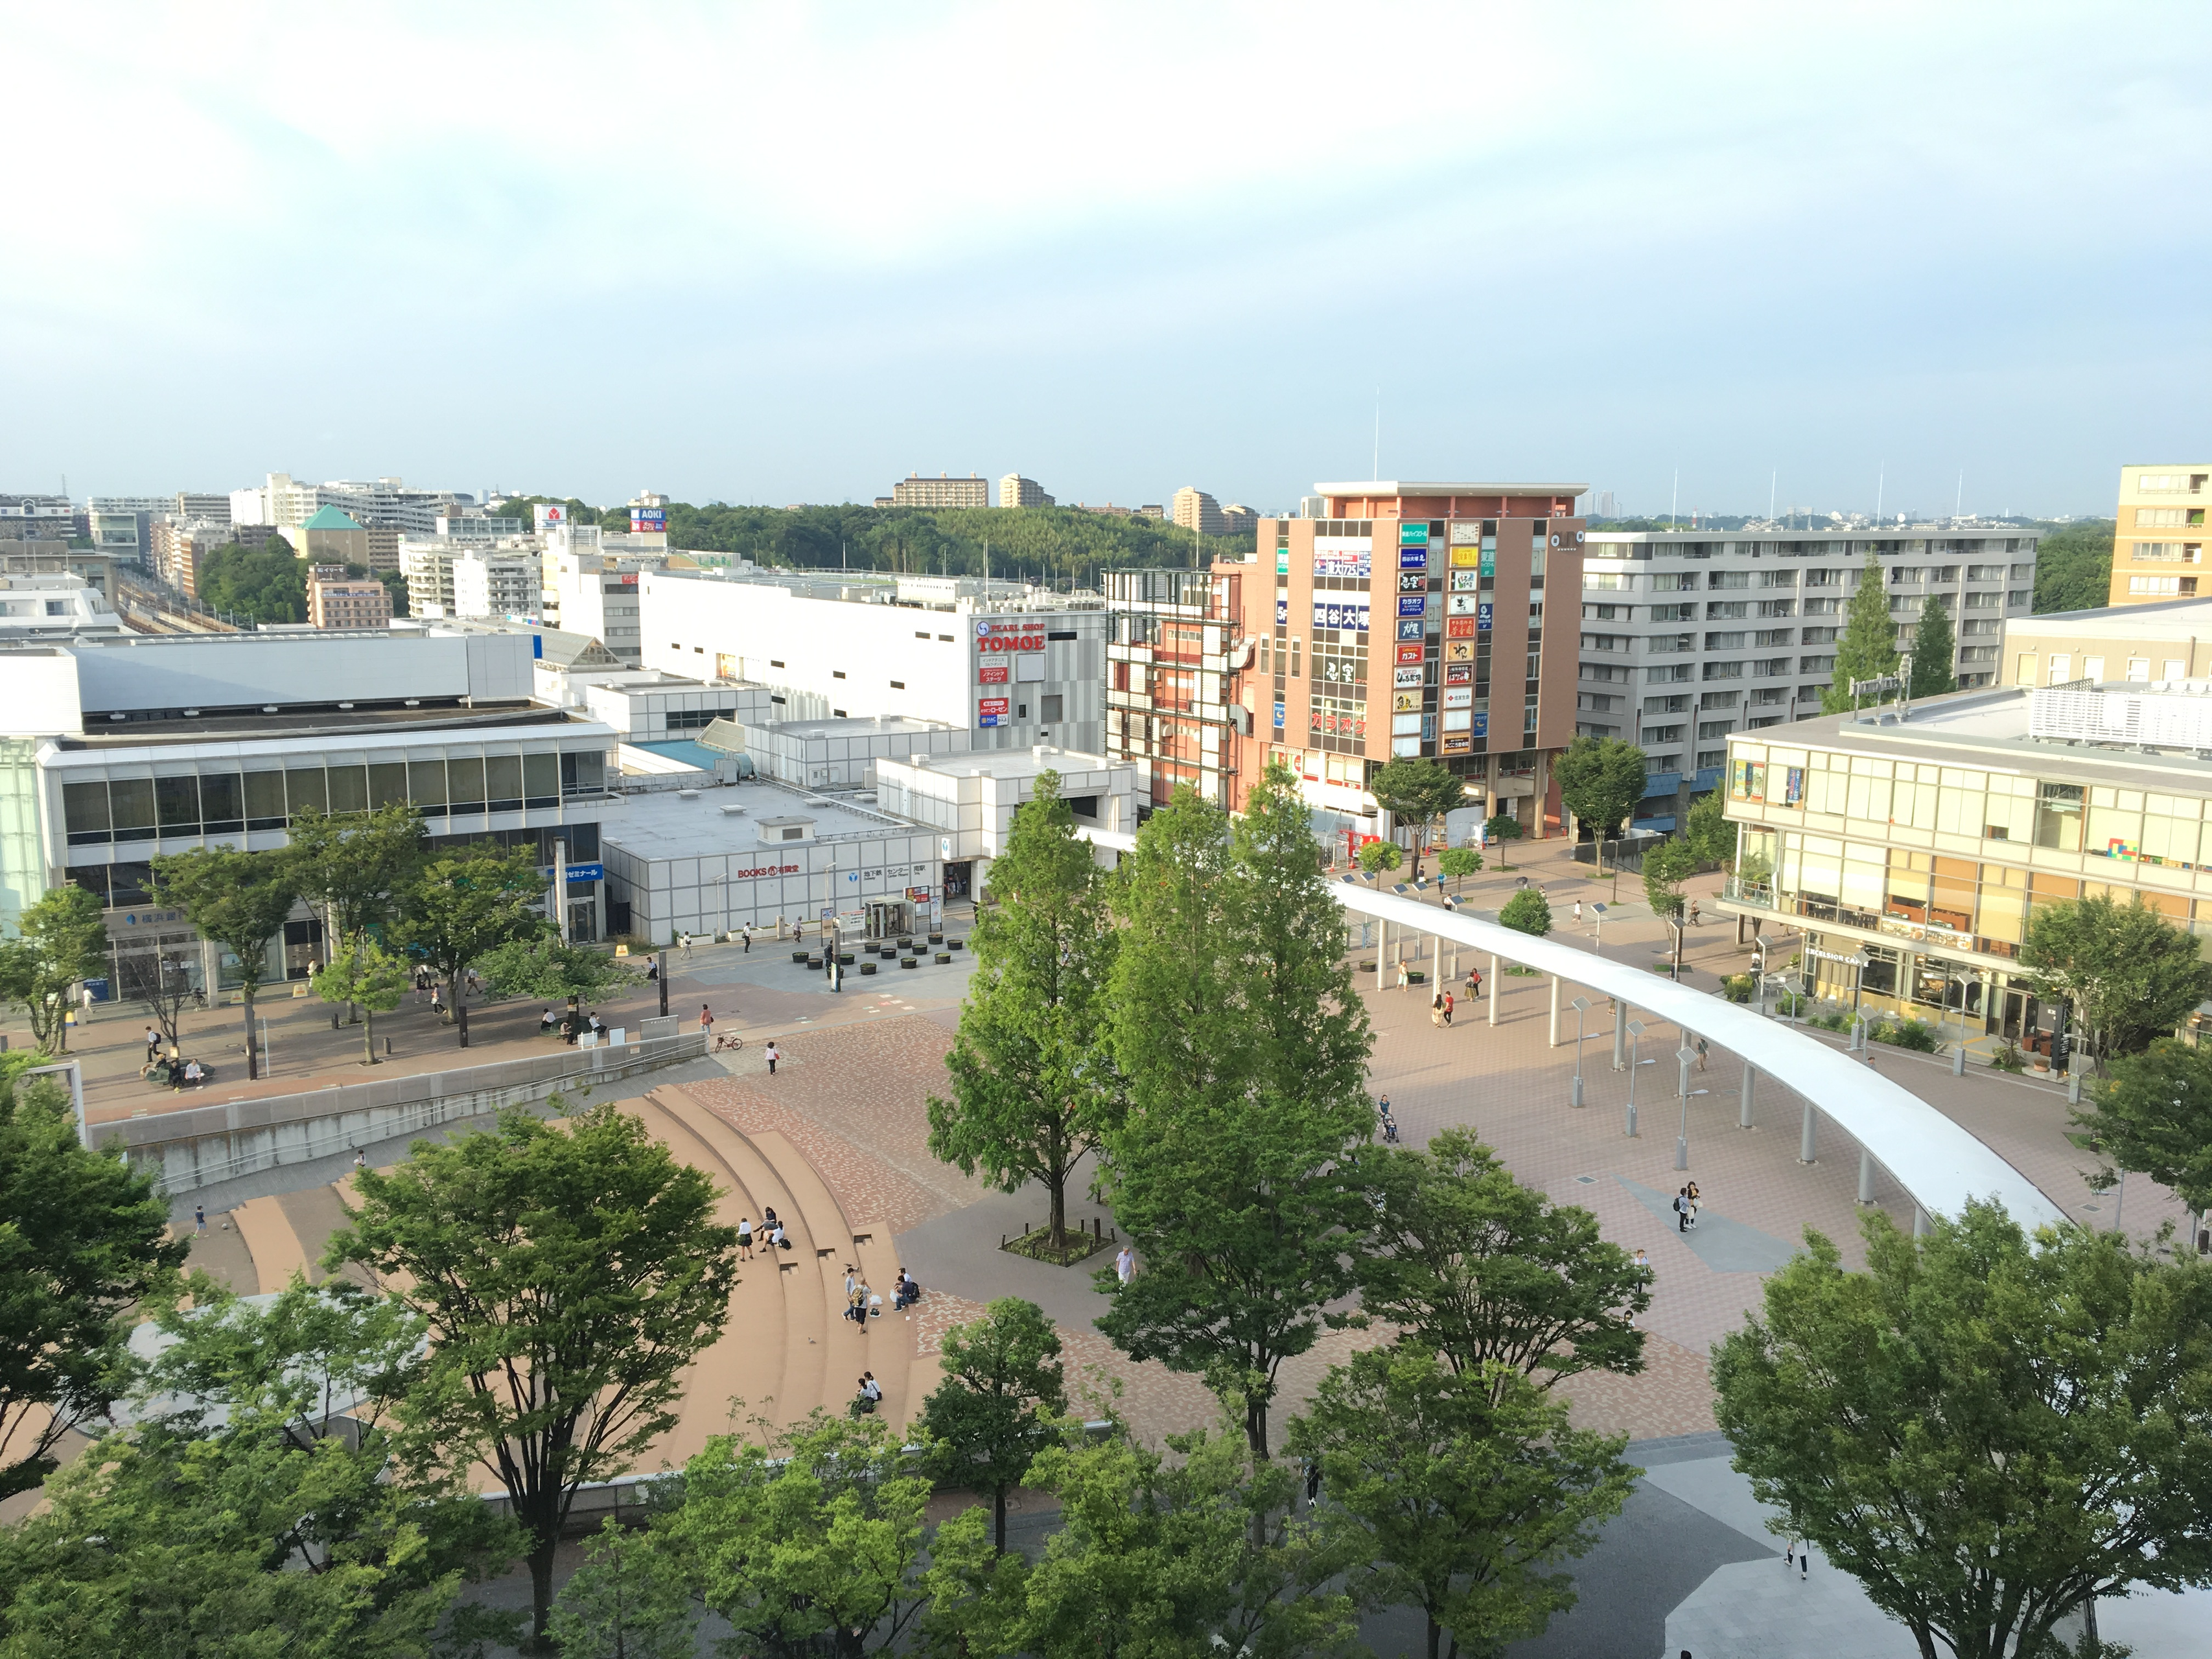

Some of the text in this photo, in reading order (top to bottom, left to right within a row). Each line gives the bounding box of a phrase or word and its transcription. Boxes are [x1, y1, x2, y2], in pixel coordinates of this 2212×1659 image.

[642, 510, 662, 518] AOKI
[1314, 609, 1370, 627] 四谷大塚
[977, 635, 1045, 652] TOMOE
[1310, 712, 1367, 734] カラオケ
[565, 869, 598, 879] ゼミナール
[738, 868, 767, 878] BOOKS
[1805, 947, 1869, 968] EXCELSIOR CAFE
